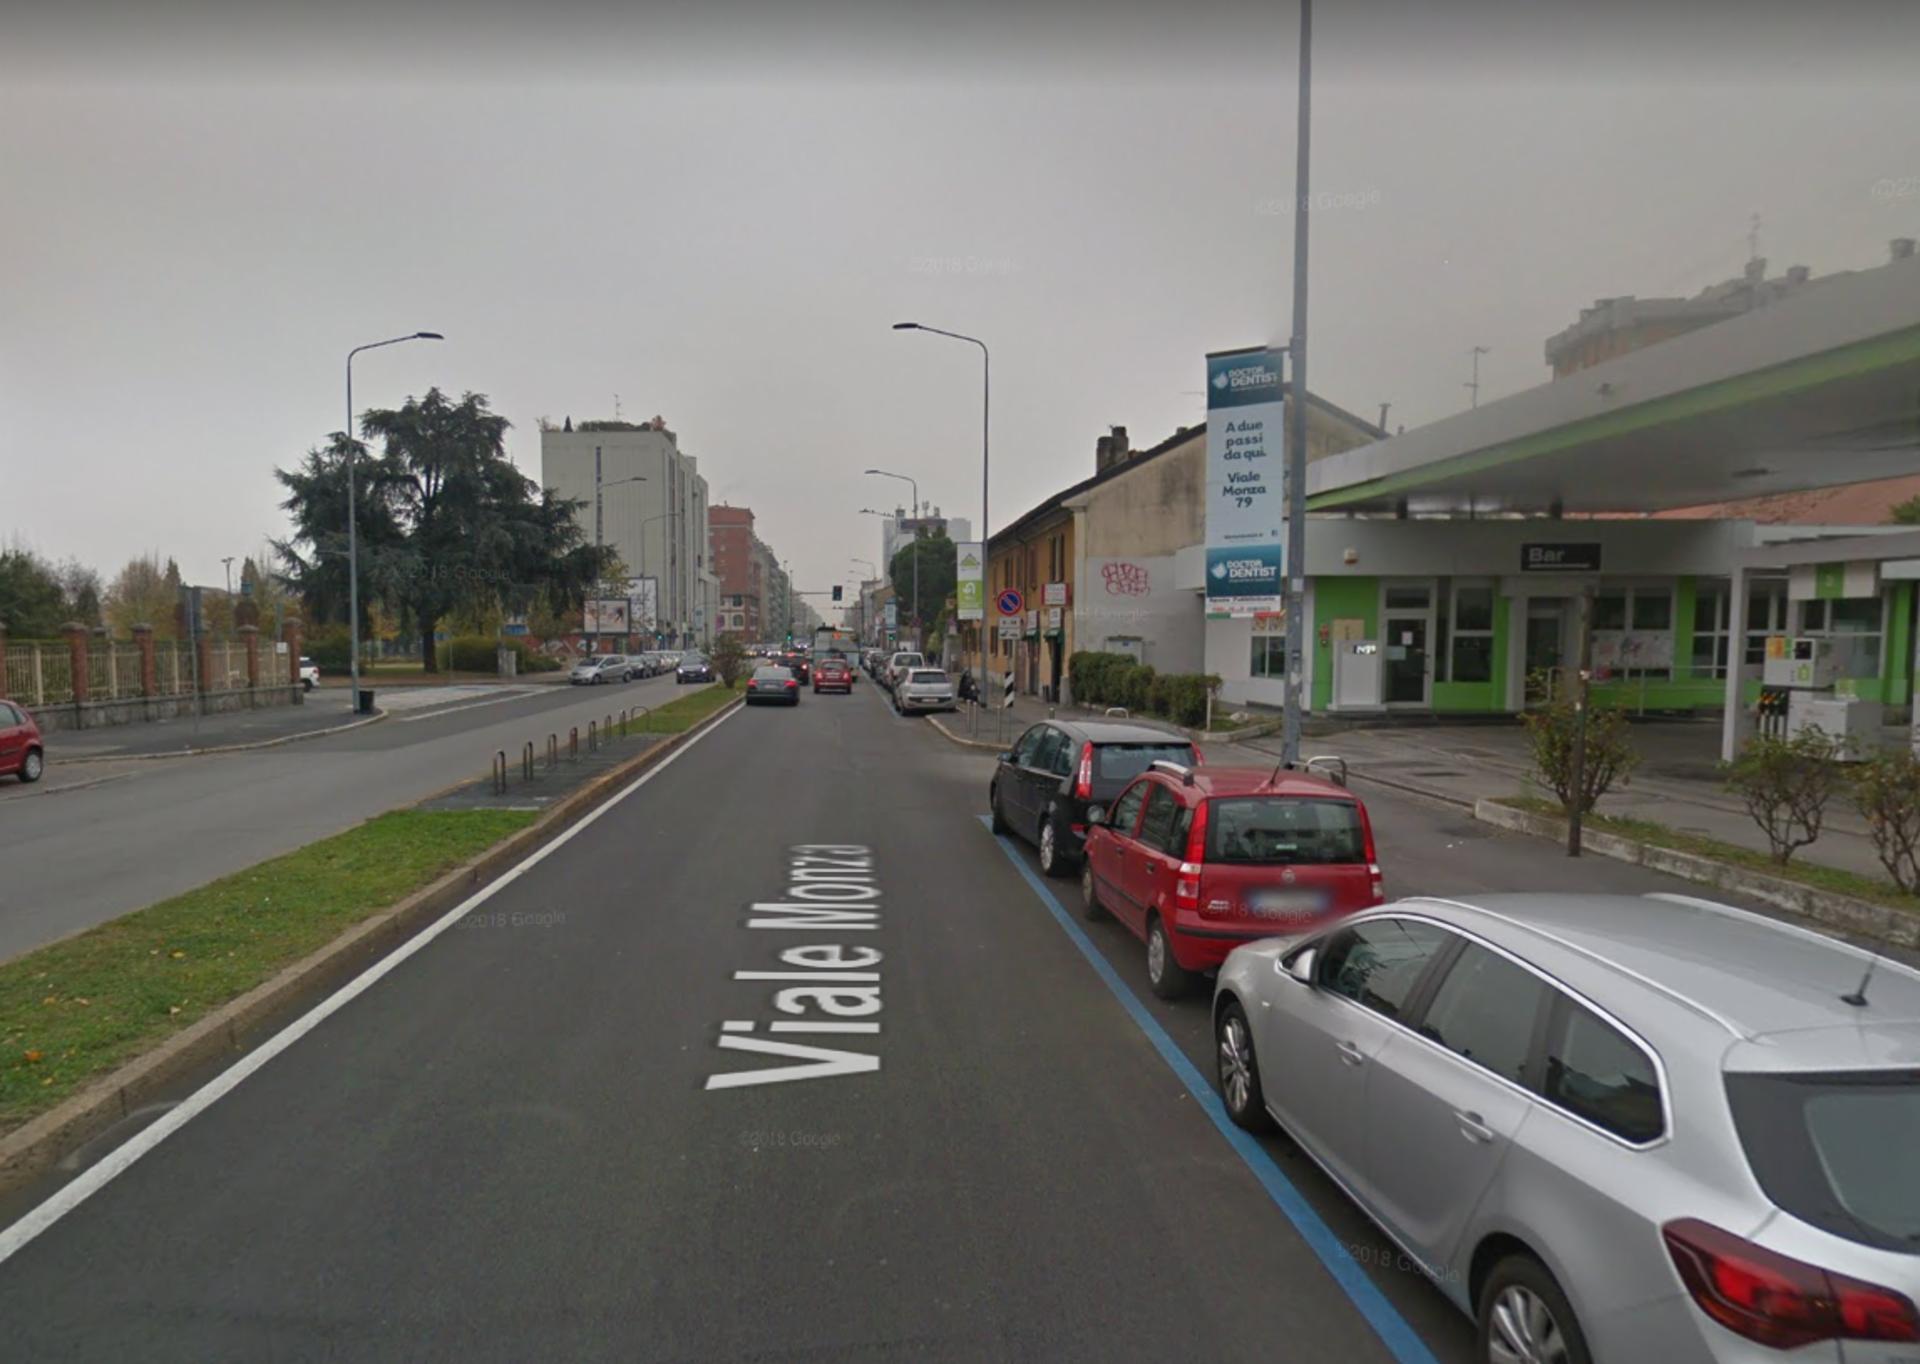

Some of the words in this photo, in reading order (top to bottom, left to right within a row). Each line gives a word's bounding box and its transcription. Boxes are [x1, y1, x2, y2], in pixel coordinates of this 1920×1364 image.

[1228, 365, 1265, 378] DOCTOR
[1231, 372, 1279, 388] DENTIST
[1225, 421, 1236, 433] A
[1237, 420, 1263, 432] due
[1226, 432, 1263, 449] passi
[1223, 449, 1241, 460] da
[1227, 471, 1261, 483] Viale
[1222, 485, 1266, 497] Monza
[1235, 496, 1253, 508] 79
[1529, 547, 1566, 561] Bar
[1226, 559, 1263, 569] DOCTOR
[1229, 566, 1277, 578] DENTIST
